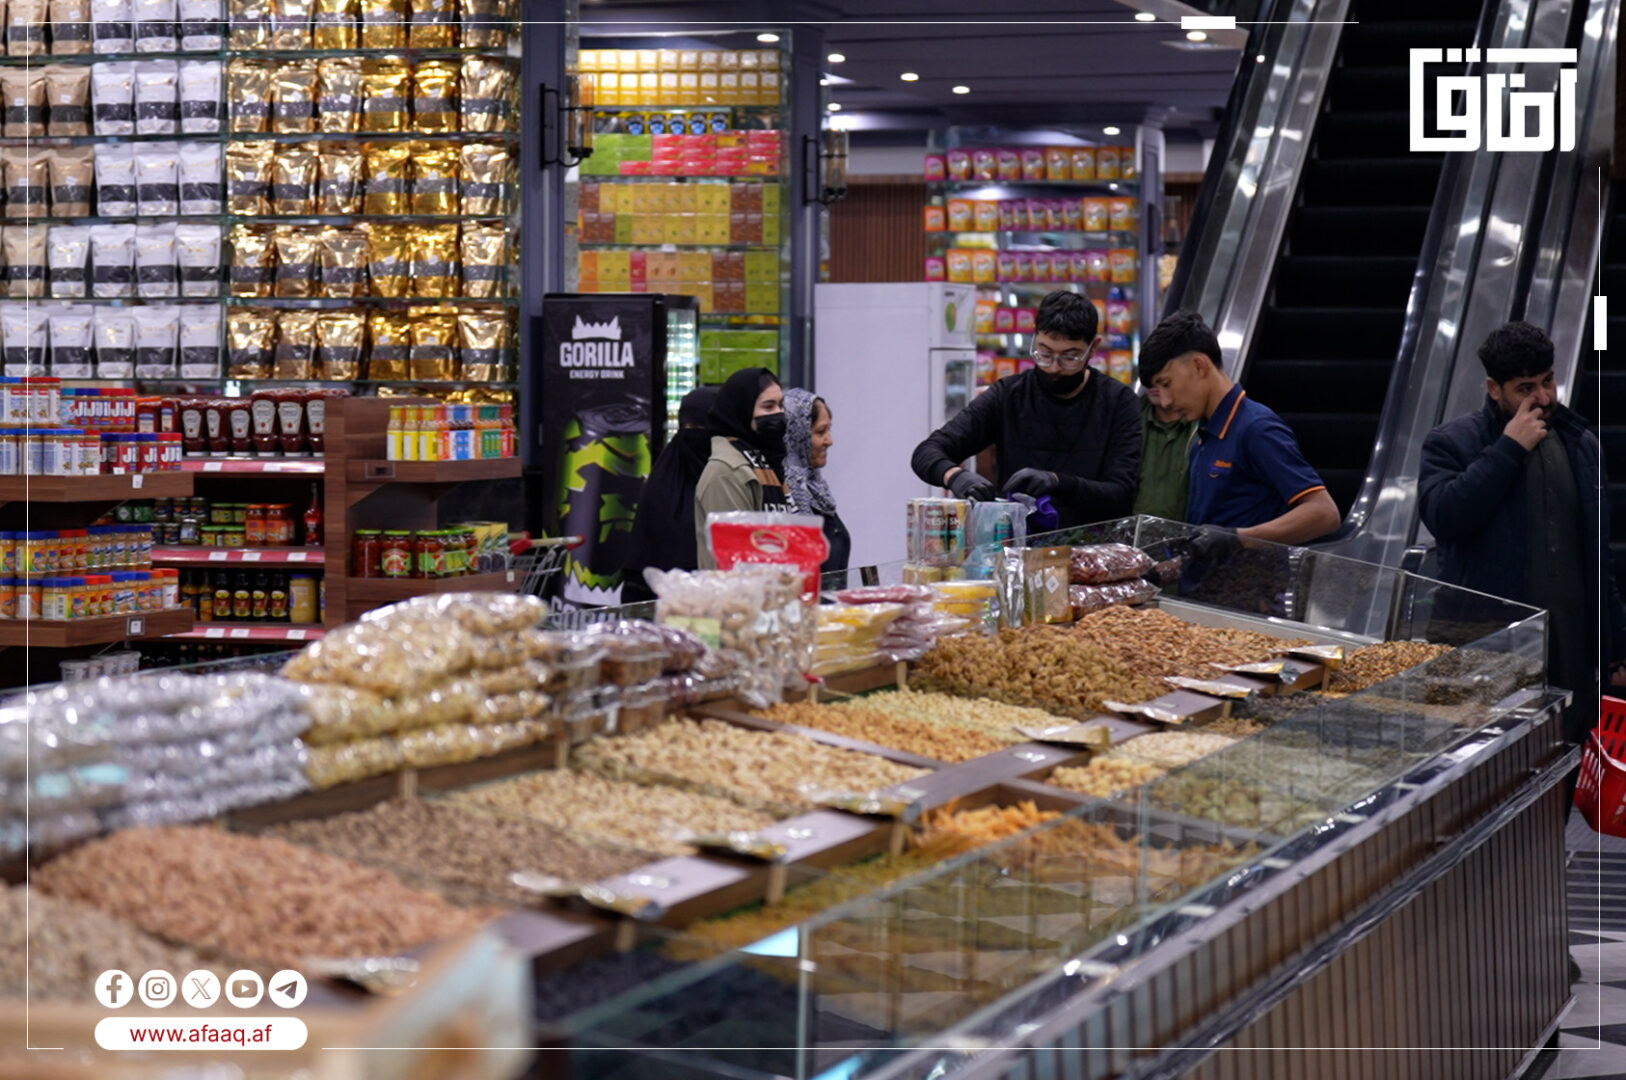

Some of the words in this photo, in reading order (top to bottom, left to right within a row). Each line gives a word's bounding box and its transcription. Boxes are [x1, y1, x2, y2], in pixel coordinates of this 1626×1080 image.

[560, 341, 635, 368] GORILLA
[569, 369, 600, 379] ENERGY
[600, 369, 625, 379] DRINK
